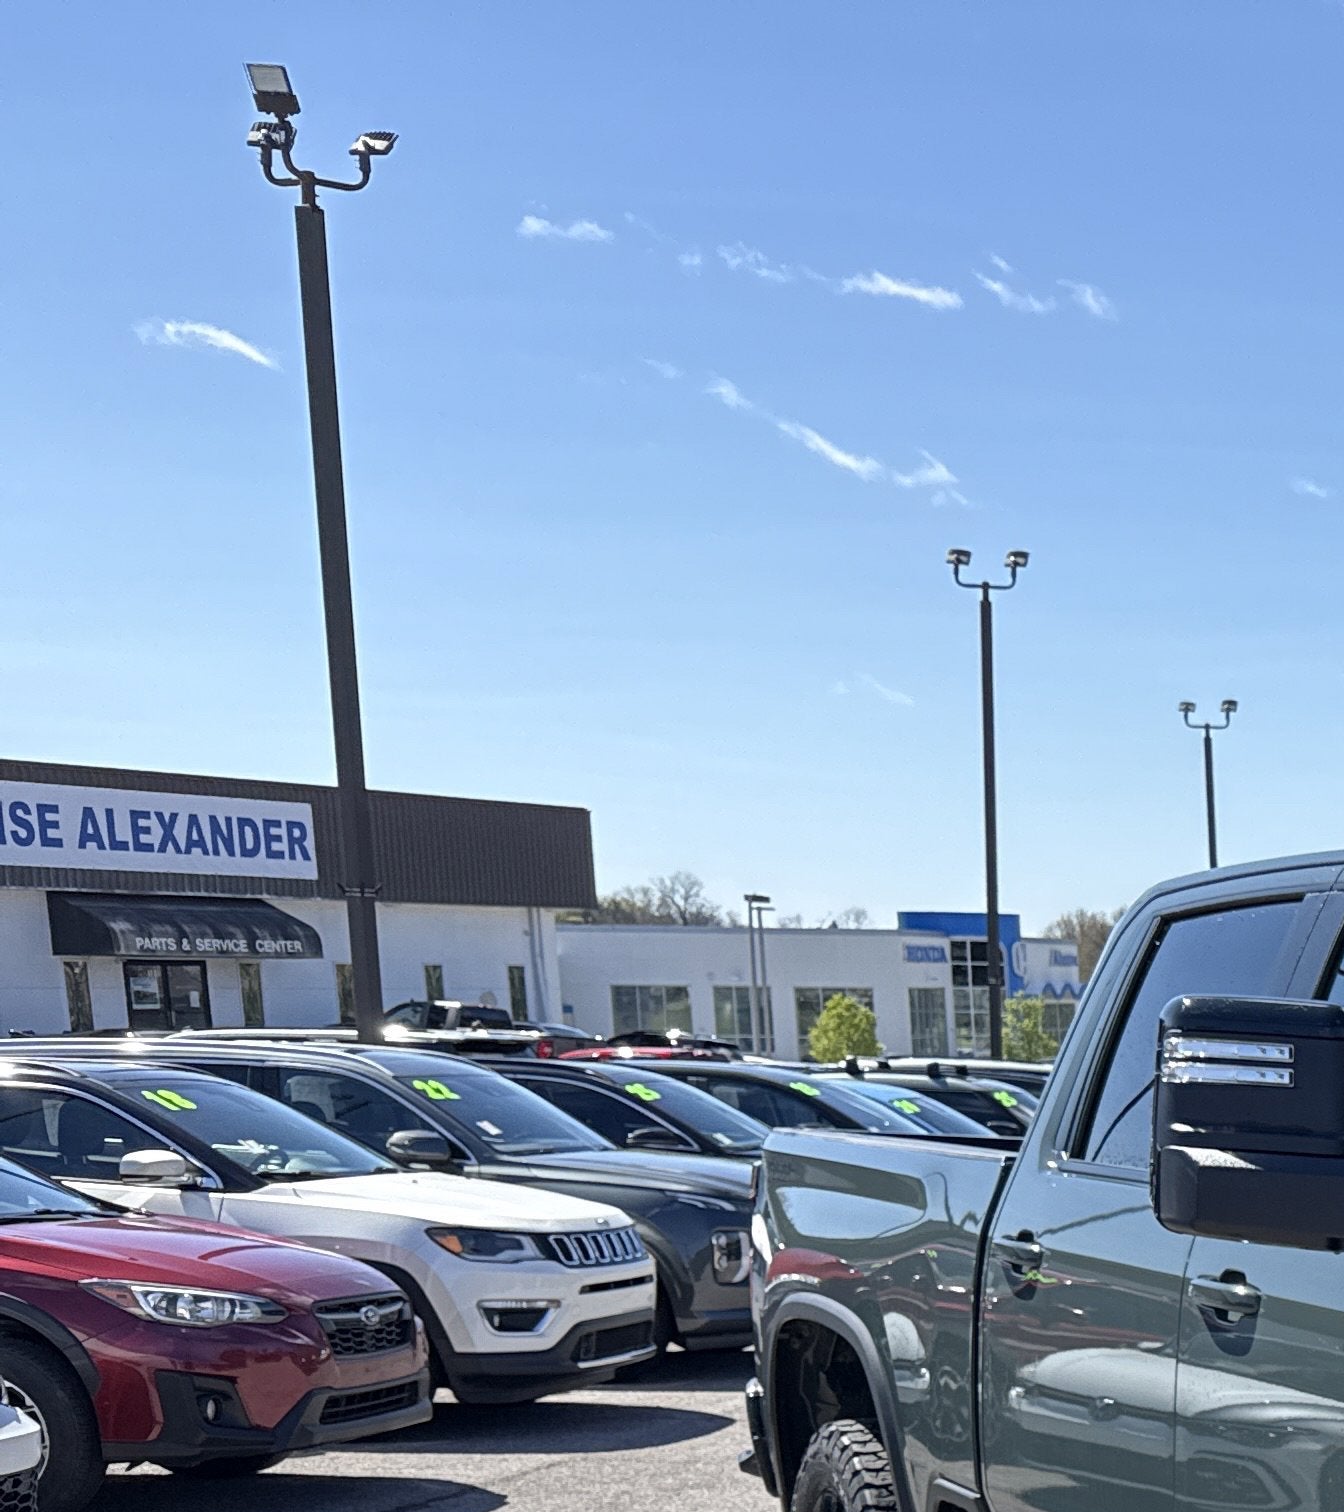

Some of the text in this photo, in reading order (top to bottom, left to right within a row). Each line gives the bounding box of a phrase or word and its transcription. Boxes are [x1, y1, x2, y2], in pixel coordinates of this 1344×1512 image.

[78, 806, 312, 861] ALEXANDER
[135, 937, 302, 953] PARTS & SERVICE CENTER
